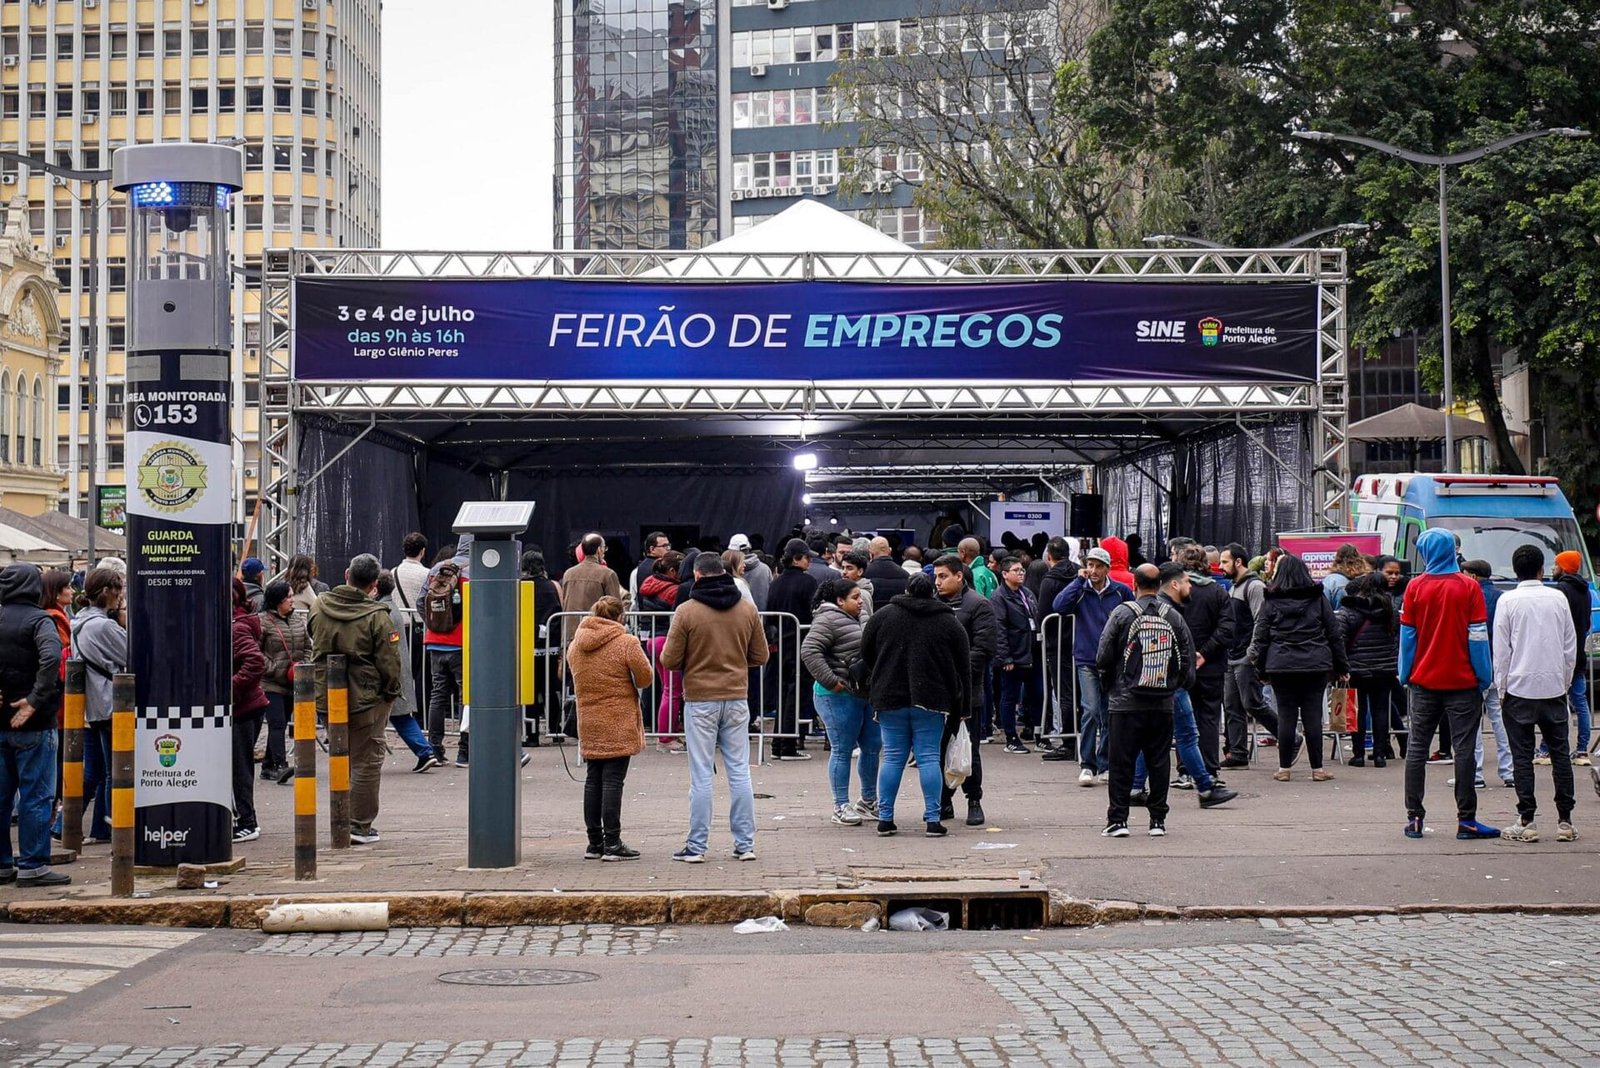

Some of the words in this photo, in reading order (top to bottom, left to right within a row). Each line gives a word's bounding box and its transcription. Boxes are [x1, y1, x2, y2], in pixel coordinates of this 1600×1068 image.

[338, 306, 350, 321] 3
[355, 309, 367, 321] e
[371, 306, 385, 321] 4
[390, 305, 416, 321] de
[420, 305, 475, 325] julho
[549, 305, 716, 348] FEIRÃO
[728, 313, 792, 348] DE
[804, 313, 1064, 348] EMPREGOS
[1136, 320, 1186, 337] SINE
[1224, 326, 1263, 335] Prefeitura
[1264, 326, 1276, 335] de
[347, 329, 380, 343] das
[385, 329, 407, 343] 9h
[411, 329, 432, 343] às
[436, 329, 465, 343] 16h
[1222, 334, 1246, 343] Porto
[1248, 334, 1277, 345] Alegre
[354, 347, 386, 359] Largo
[388, 347, 425, 357] Glênio
[428, 347, 459, 357] Peres
[148, 391, 227, 402] MONITORADA
[154, 404, 198, 424] 153
[147, 530, 194, 541] GUARDA
[141, 544, 201, 555] MUNICIPAL
[147, 578, 172, 586] DESDE
[174, 578, 192, 586] 1892
[142, 769, 181, 777] Prefeitura
[184, 769, 195, 777] de
[140, 778, 163, 787] Porto
[166, 778, 198, 788] Alegre
[144, 825, 189, 849] helper
